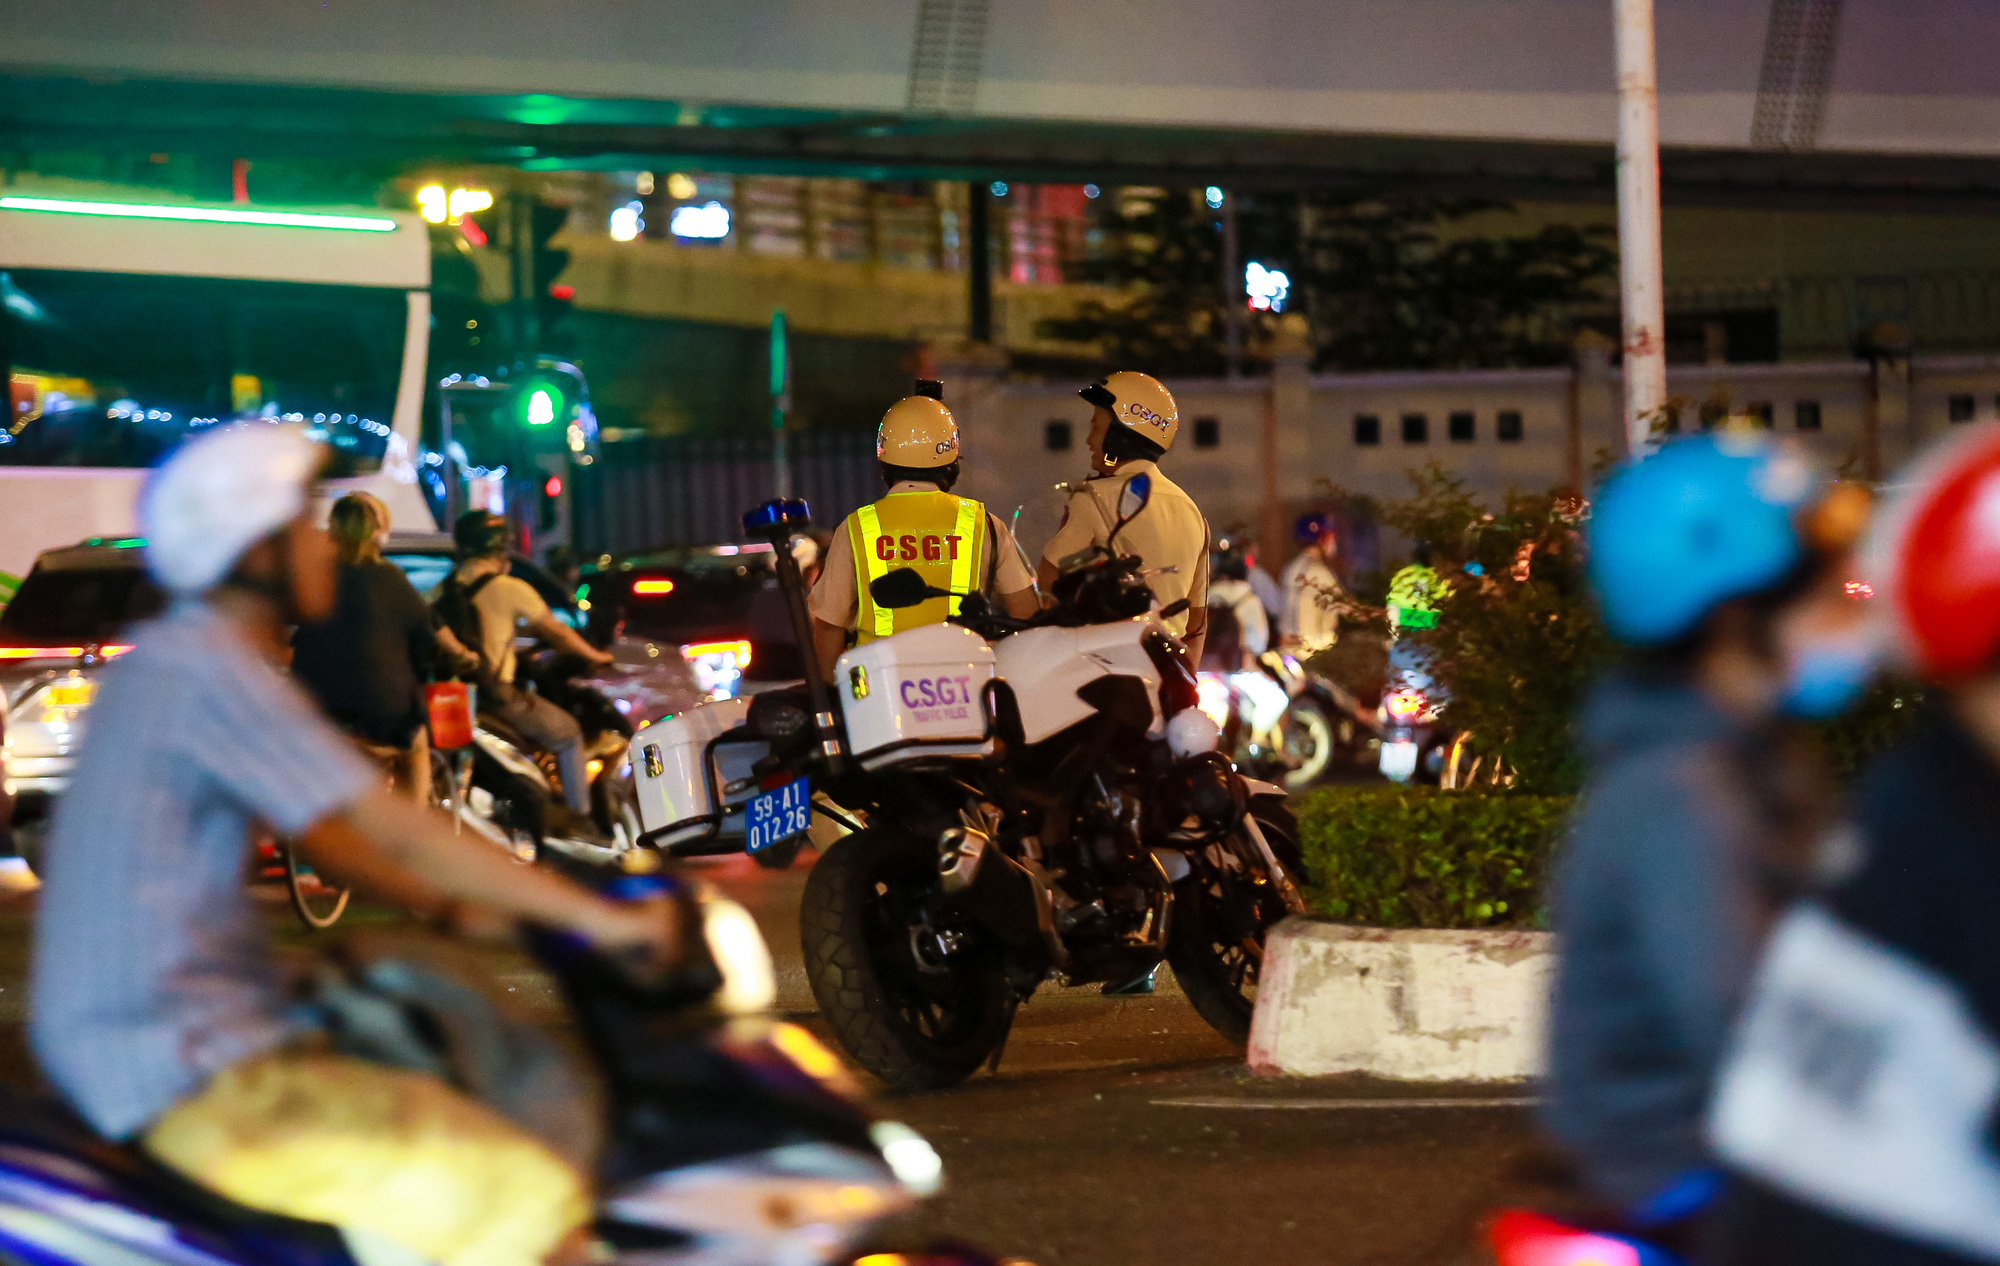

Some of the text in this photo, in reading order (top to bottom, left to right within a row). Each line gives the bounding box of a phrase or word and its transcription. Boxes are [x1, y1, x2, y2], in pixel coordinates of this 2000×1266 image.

[1130, 403, 1170, 432] CSGT
[876, 535, 962, 561] CSGT
[754, 783, 800, 822] 59-A1
[750, 806, 806, 849] 012.26
